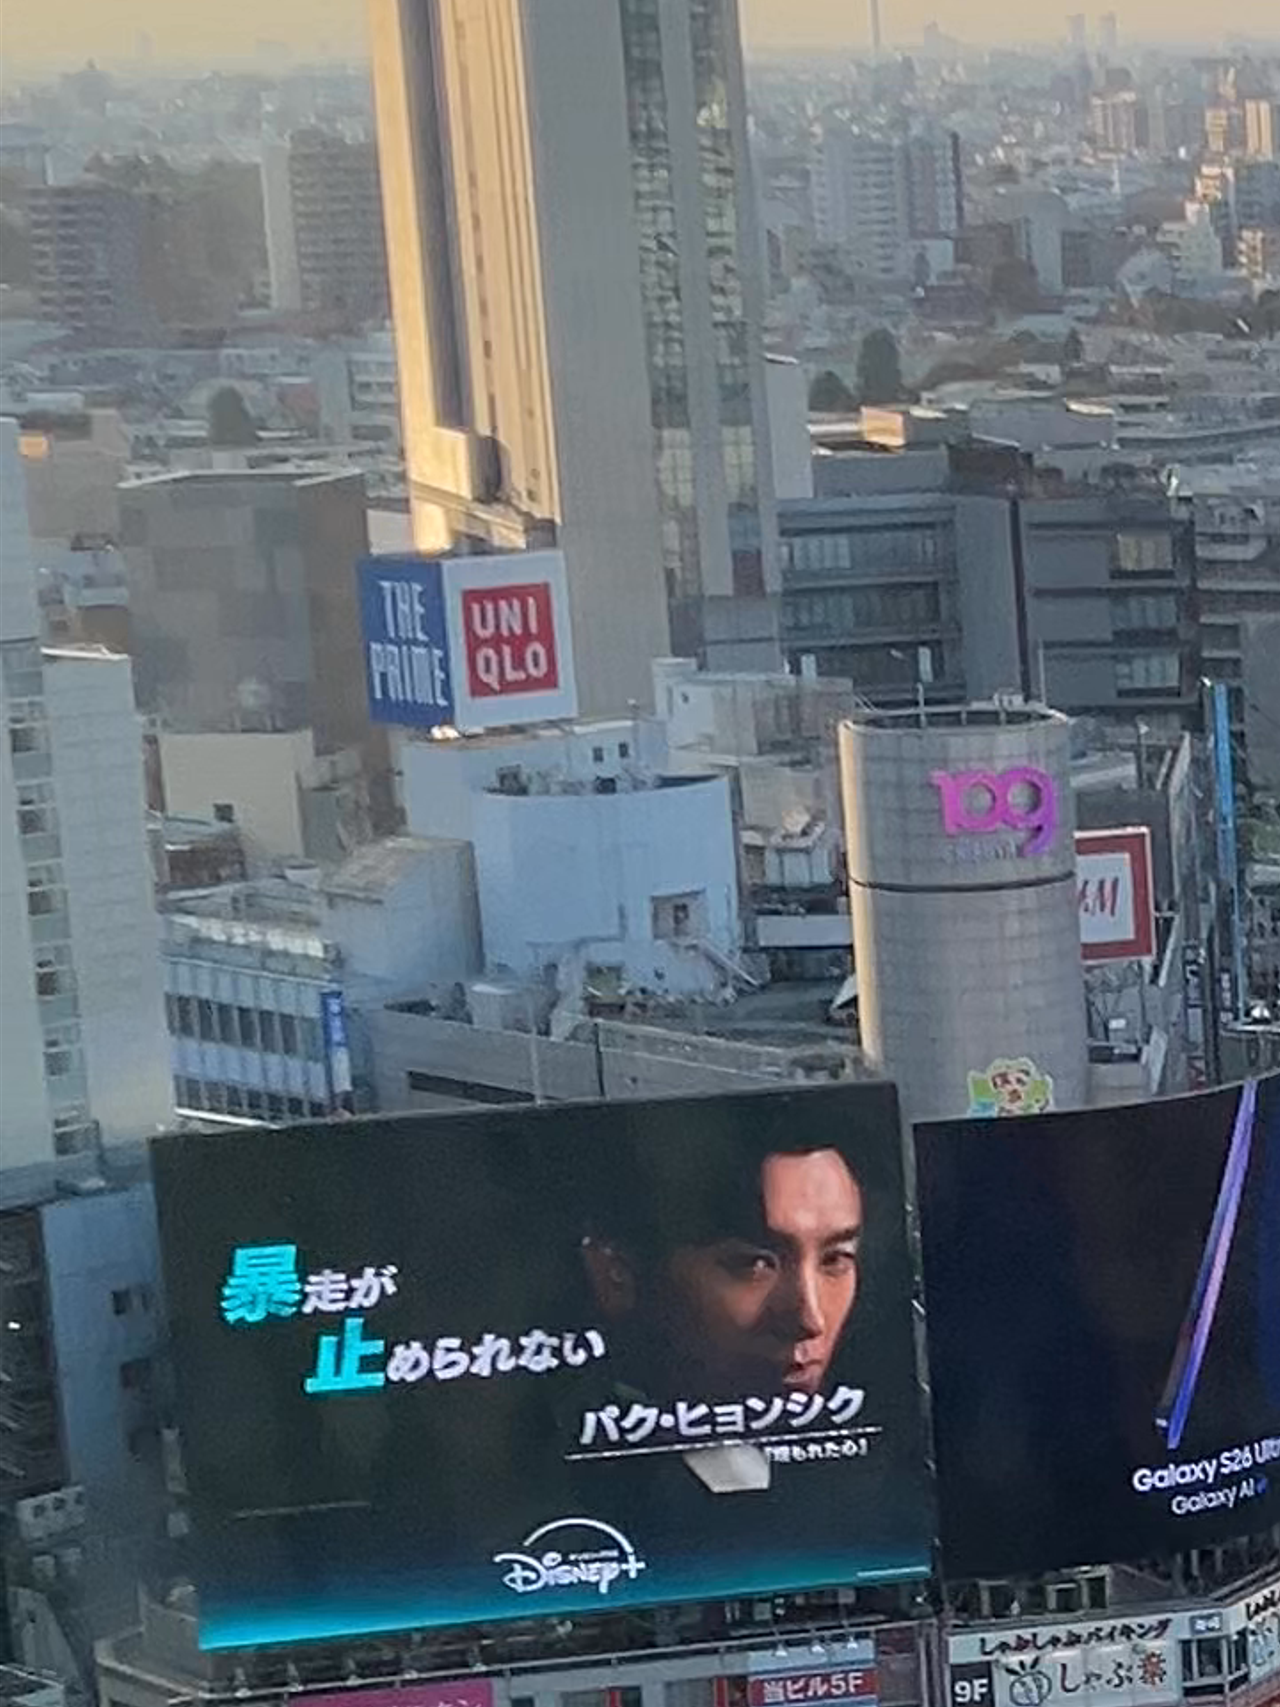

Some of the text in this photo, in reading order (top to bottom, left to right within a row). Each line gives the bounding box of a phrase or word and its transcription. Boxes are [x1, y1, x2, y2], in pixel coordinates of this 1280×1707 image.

[378, 579, 430, 642] THE
[471, 595, 540, 640] UNI
[368, 641, 449, 708] PRIME
[475, 640, 549, 693] QLO
[926, 766, 1058, 860] 109
[222, 1245, 400, 1325] 暴走が
[304, 1317, 606, 1395] 止められない
[578, 1385, 866, 1445] パク・ヒョンシク
[1132, 1457, 1218, 1492] Galaxy
[1171, 1485, 1238, 1515] Galaxy
[494, 1550, 647, 1594] Disney+
[979, 1617, 1174, 1657] しゃぶしゃぶバイキング
[762, 1671, 864, 1705] 当ビル5F
[953, 1677, 989, 1705] 9F
